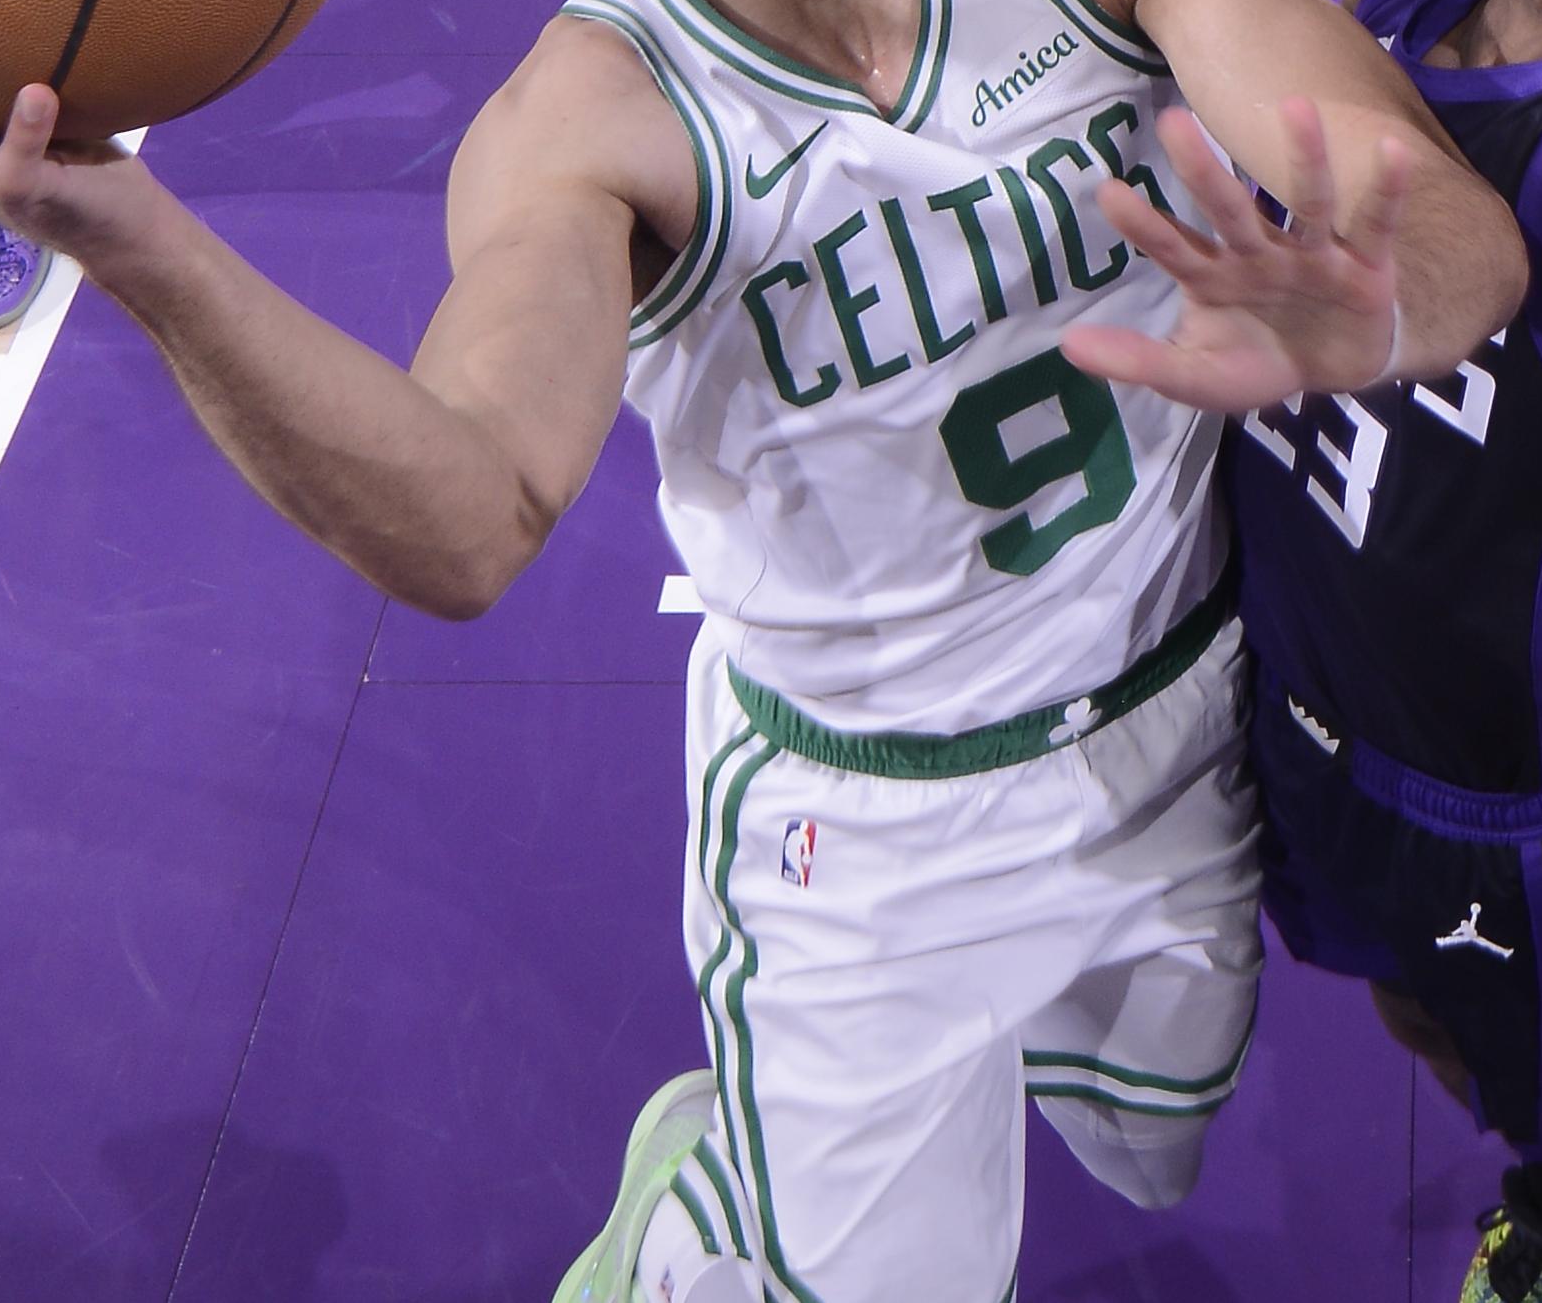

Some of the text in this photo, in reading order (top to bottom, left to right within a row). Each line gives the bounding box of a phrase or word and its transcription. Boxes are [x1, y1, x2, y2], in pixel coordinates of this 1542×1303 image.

[971, 30, 1080, 127] Amica
[741, 101, 1179, 408] CELTICS
[938, 345, 1137, 577] 9
